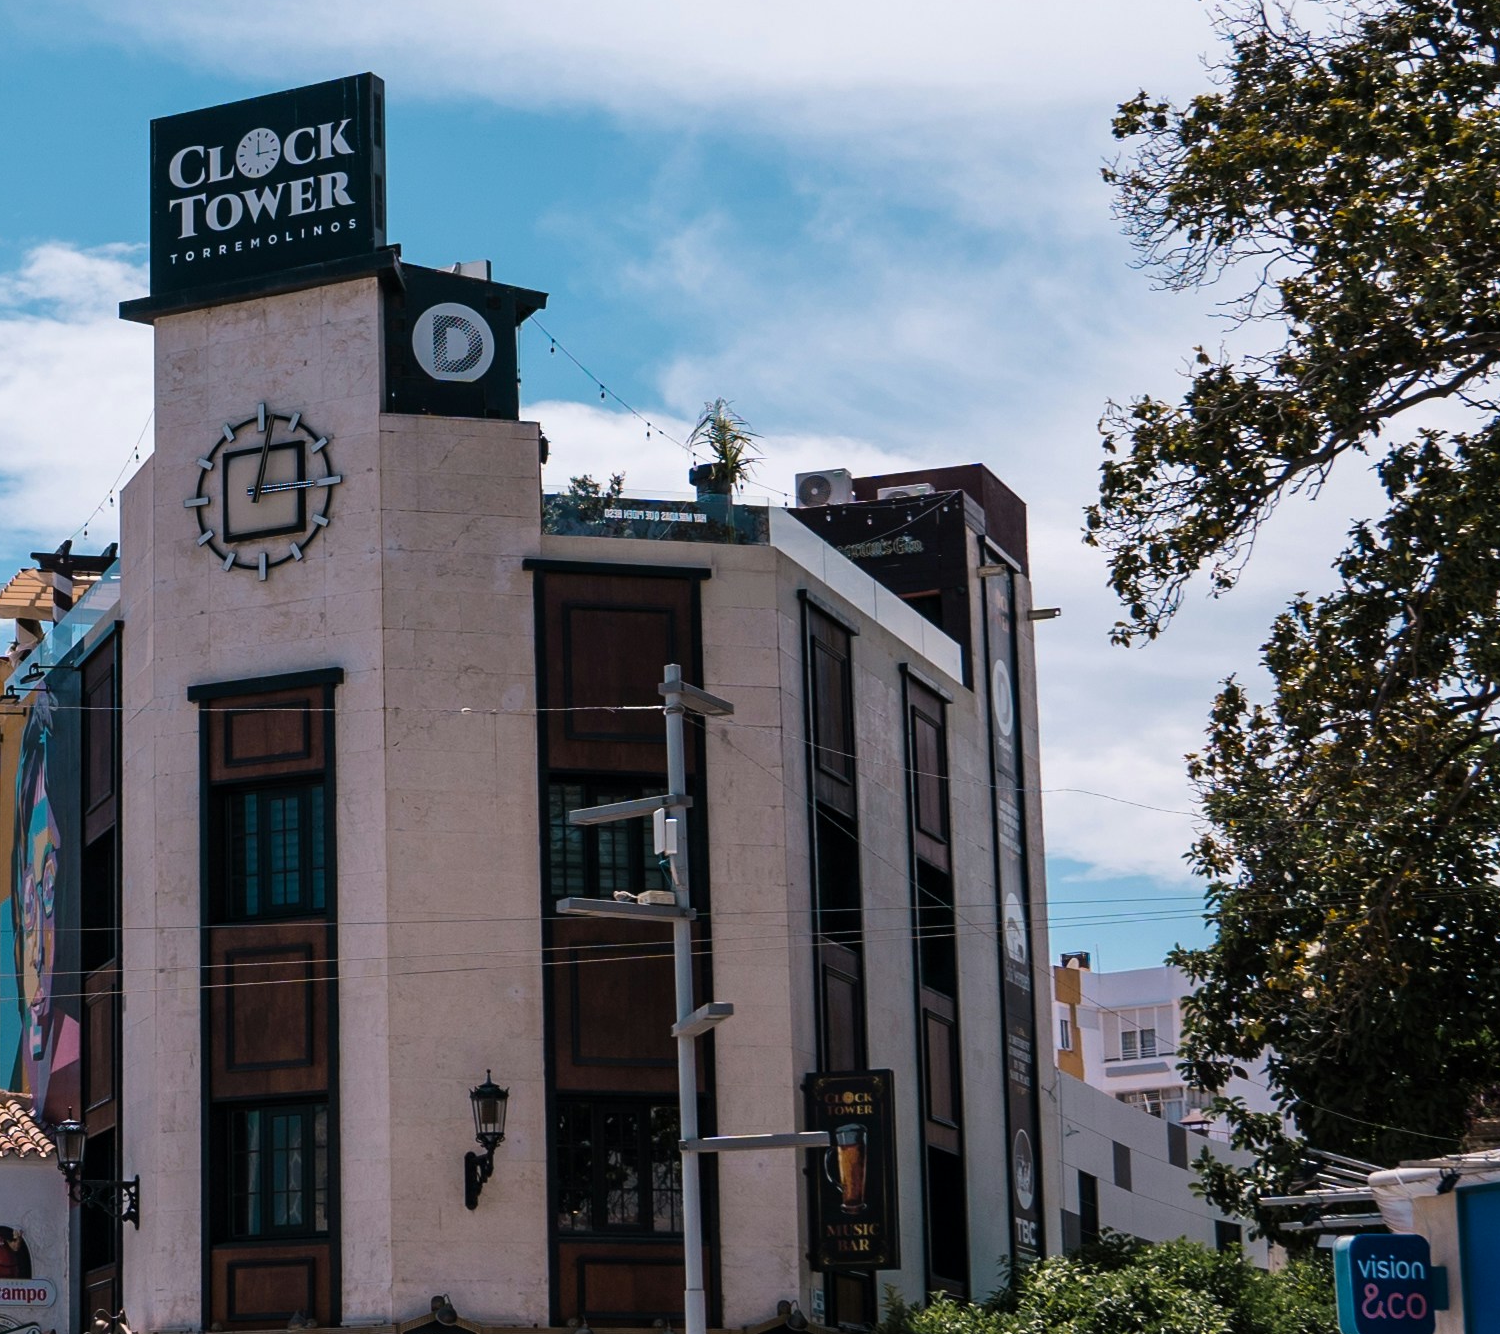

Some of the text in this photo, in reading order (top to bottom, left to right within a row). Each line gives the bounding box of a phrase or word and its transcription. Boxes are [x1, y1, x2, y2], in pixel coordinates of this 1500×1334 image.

[169, 118, 355, 179] CLOCK
[169, 171, 356, 239] TOWER
[170, 219, 357, 264] TORREMOLINOS
[1357, 1255, 1425, 1281] vision
[1361, 1284, 1427, 1321] &co
